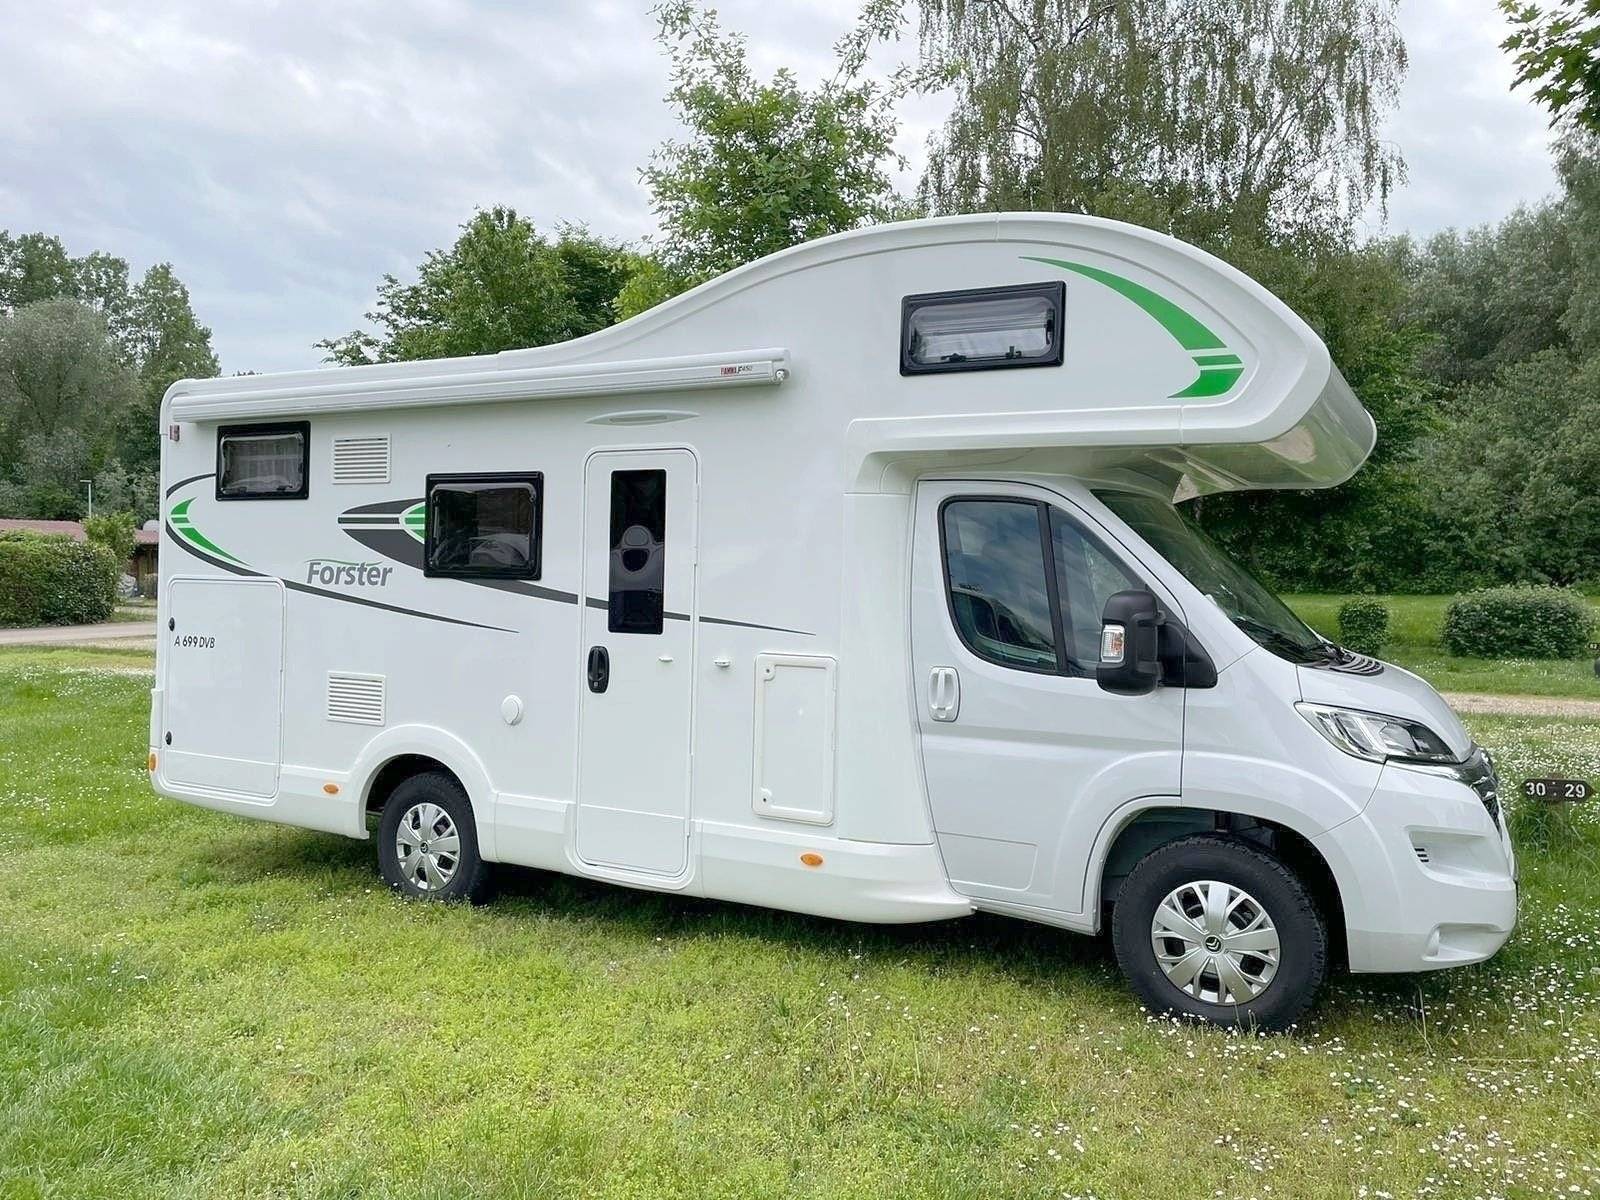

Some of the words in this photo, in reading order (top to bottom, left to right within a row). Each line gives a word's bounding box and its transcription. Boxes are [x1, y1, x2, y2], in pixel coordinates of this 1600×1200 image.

[306, 561, 393, 587] Forster
[174, 635, 180, 647] A
[182, 635, 198, 648] 699
[199, 636, 216, 649] DVB
[1525, 782, 1546, 796] 30
[1564, 783, 1586, 798] 29
